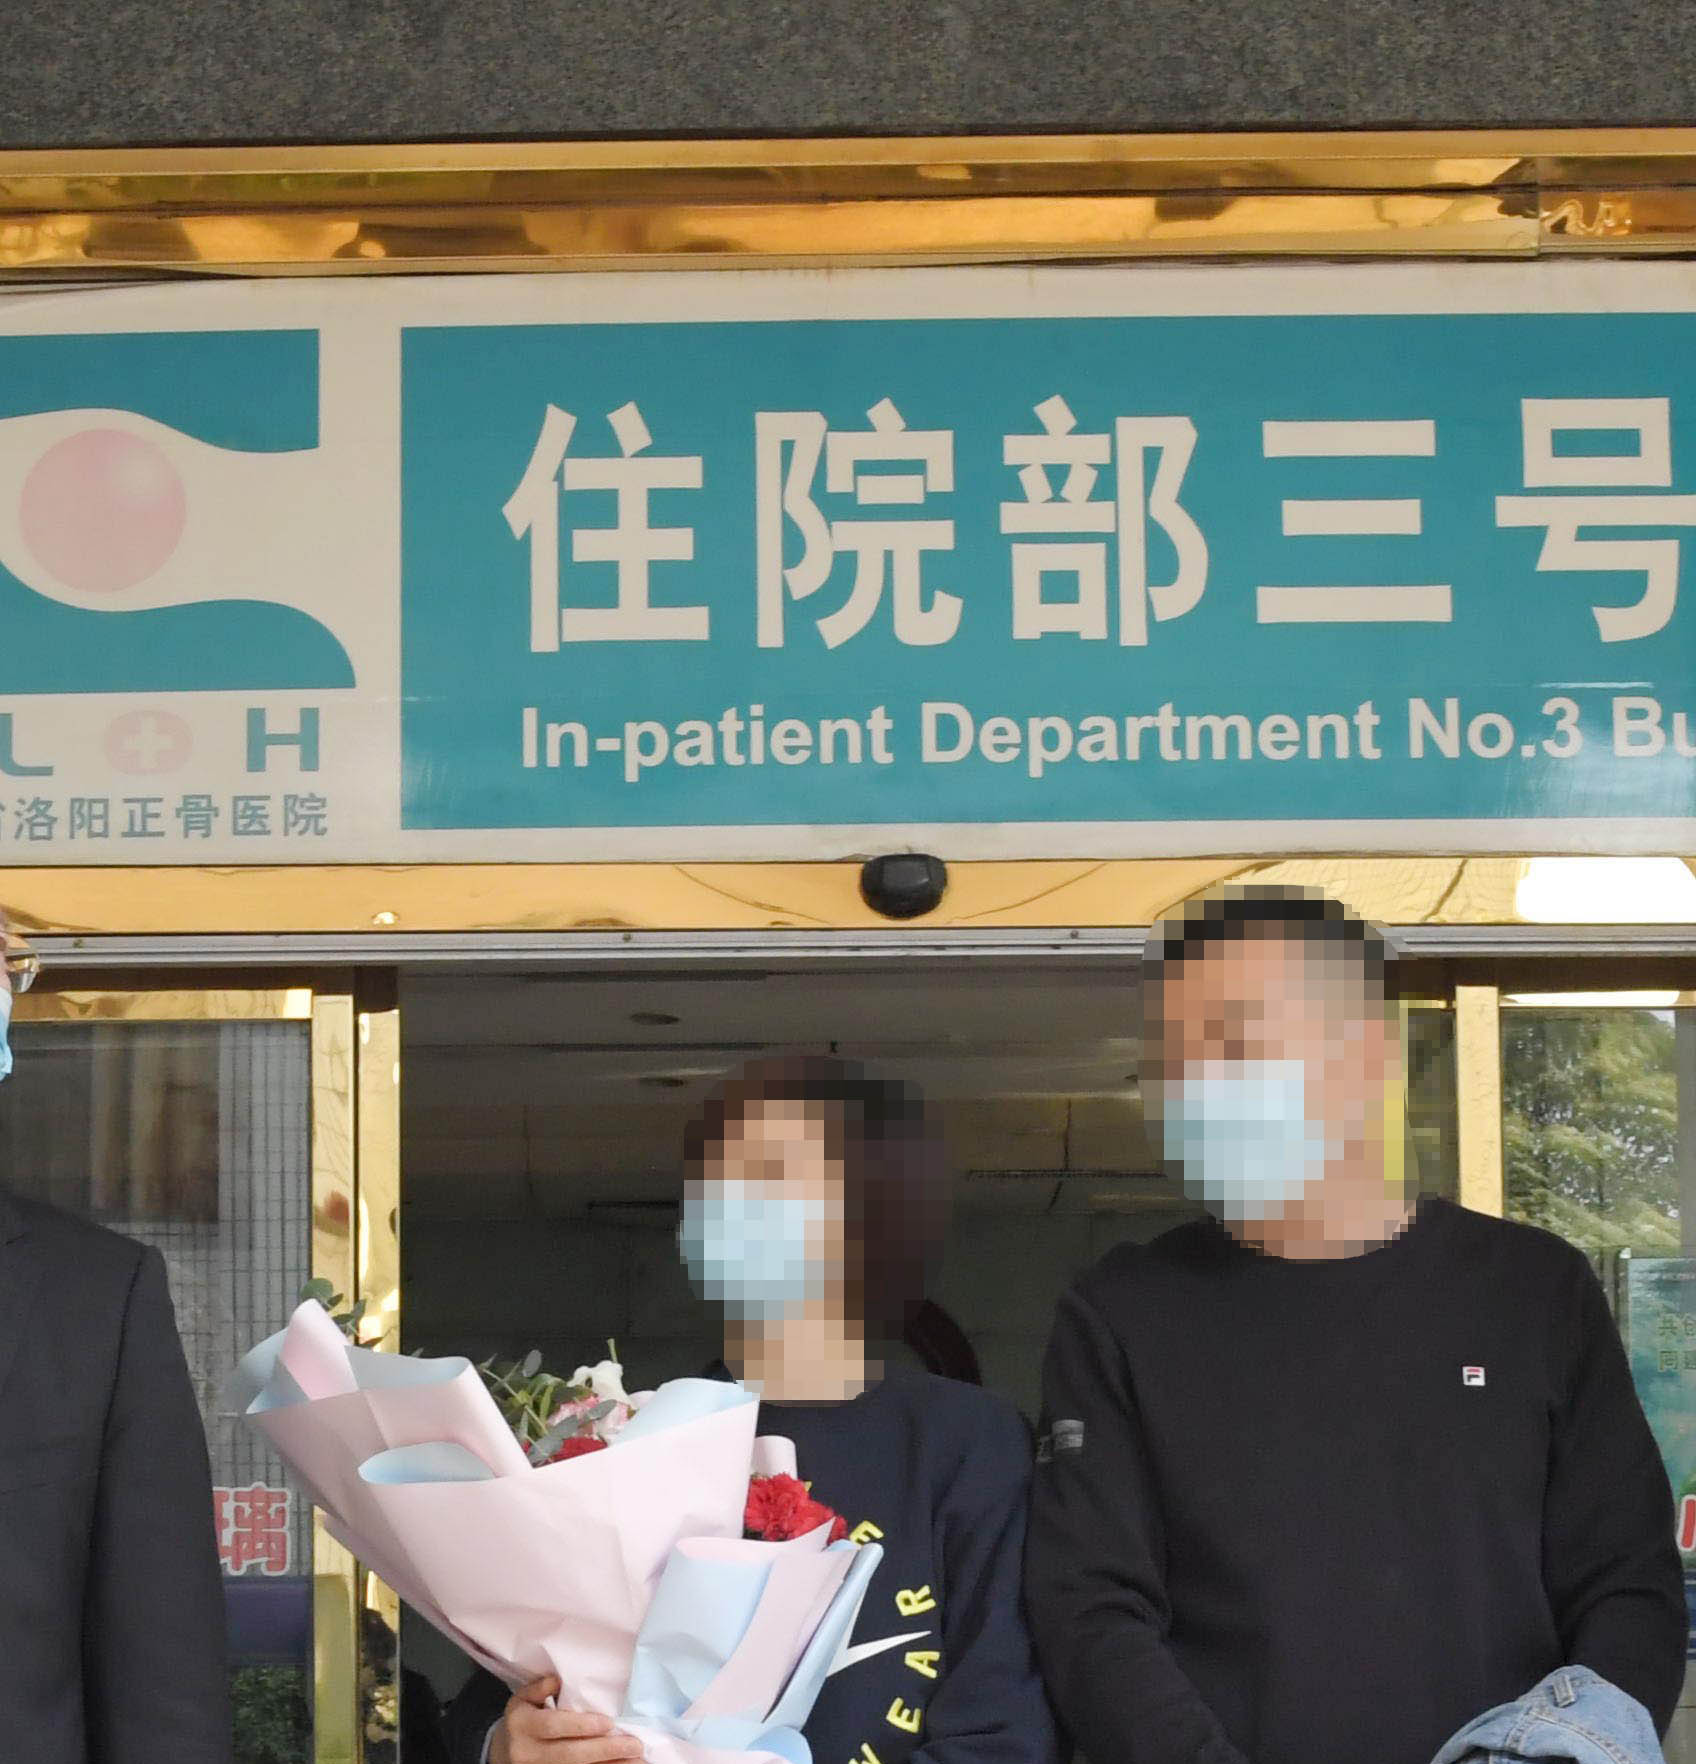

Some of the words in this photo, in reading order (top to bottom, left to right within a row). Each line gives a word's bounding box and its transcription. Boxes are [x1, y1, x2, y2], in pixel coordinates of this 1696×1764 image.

[520, 702, 894, 784] In-patient
[920, 698, 1382, 779] Department
[1408, 696, 1585, 760] No.3
